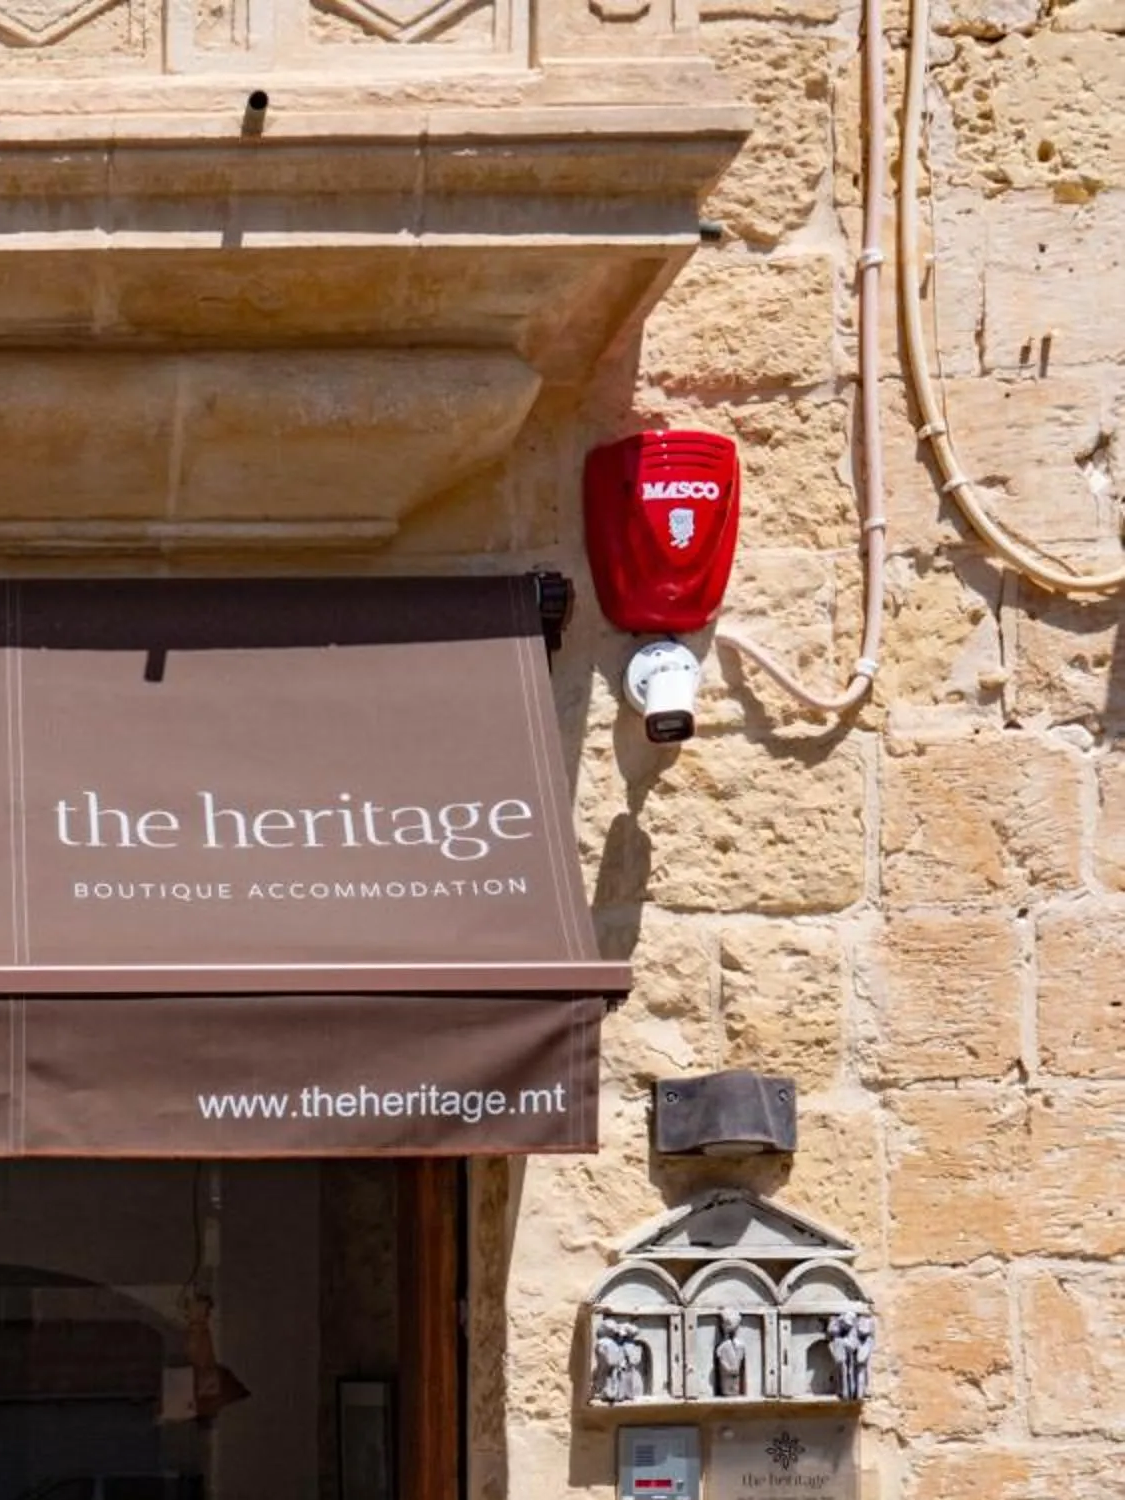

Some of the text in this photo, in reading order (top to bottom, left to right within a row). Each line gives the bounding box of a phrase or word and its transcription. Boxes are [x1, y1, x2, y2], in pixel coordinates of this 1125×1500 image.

[641, 481, 720, 500] MASCO
[54, 790, 534, 861] the heritage
[74, 877, 528, 902] BOUTIQUE ACCOMMODATION
[197, 1081, 567, 1123] www.theheritage.mt
